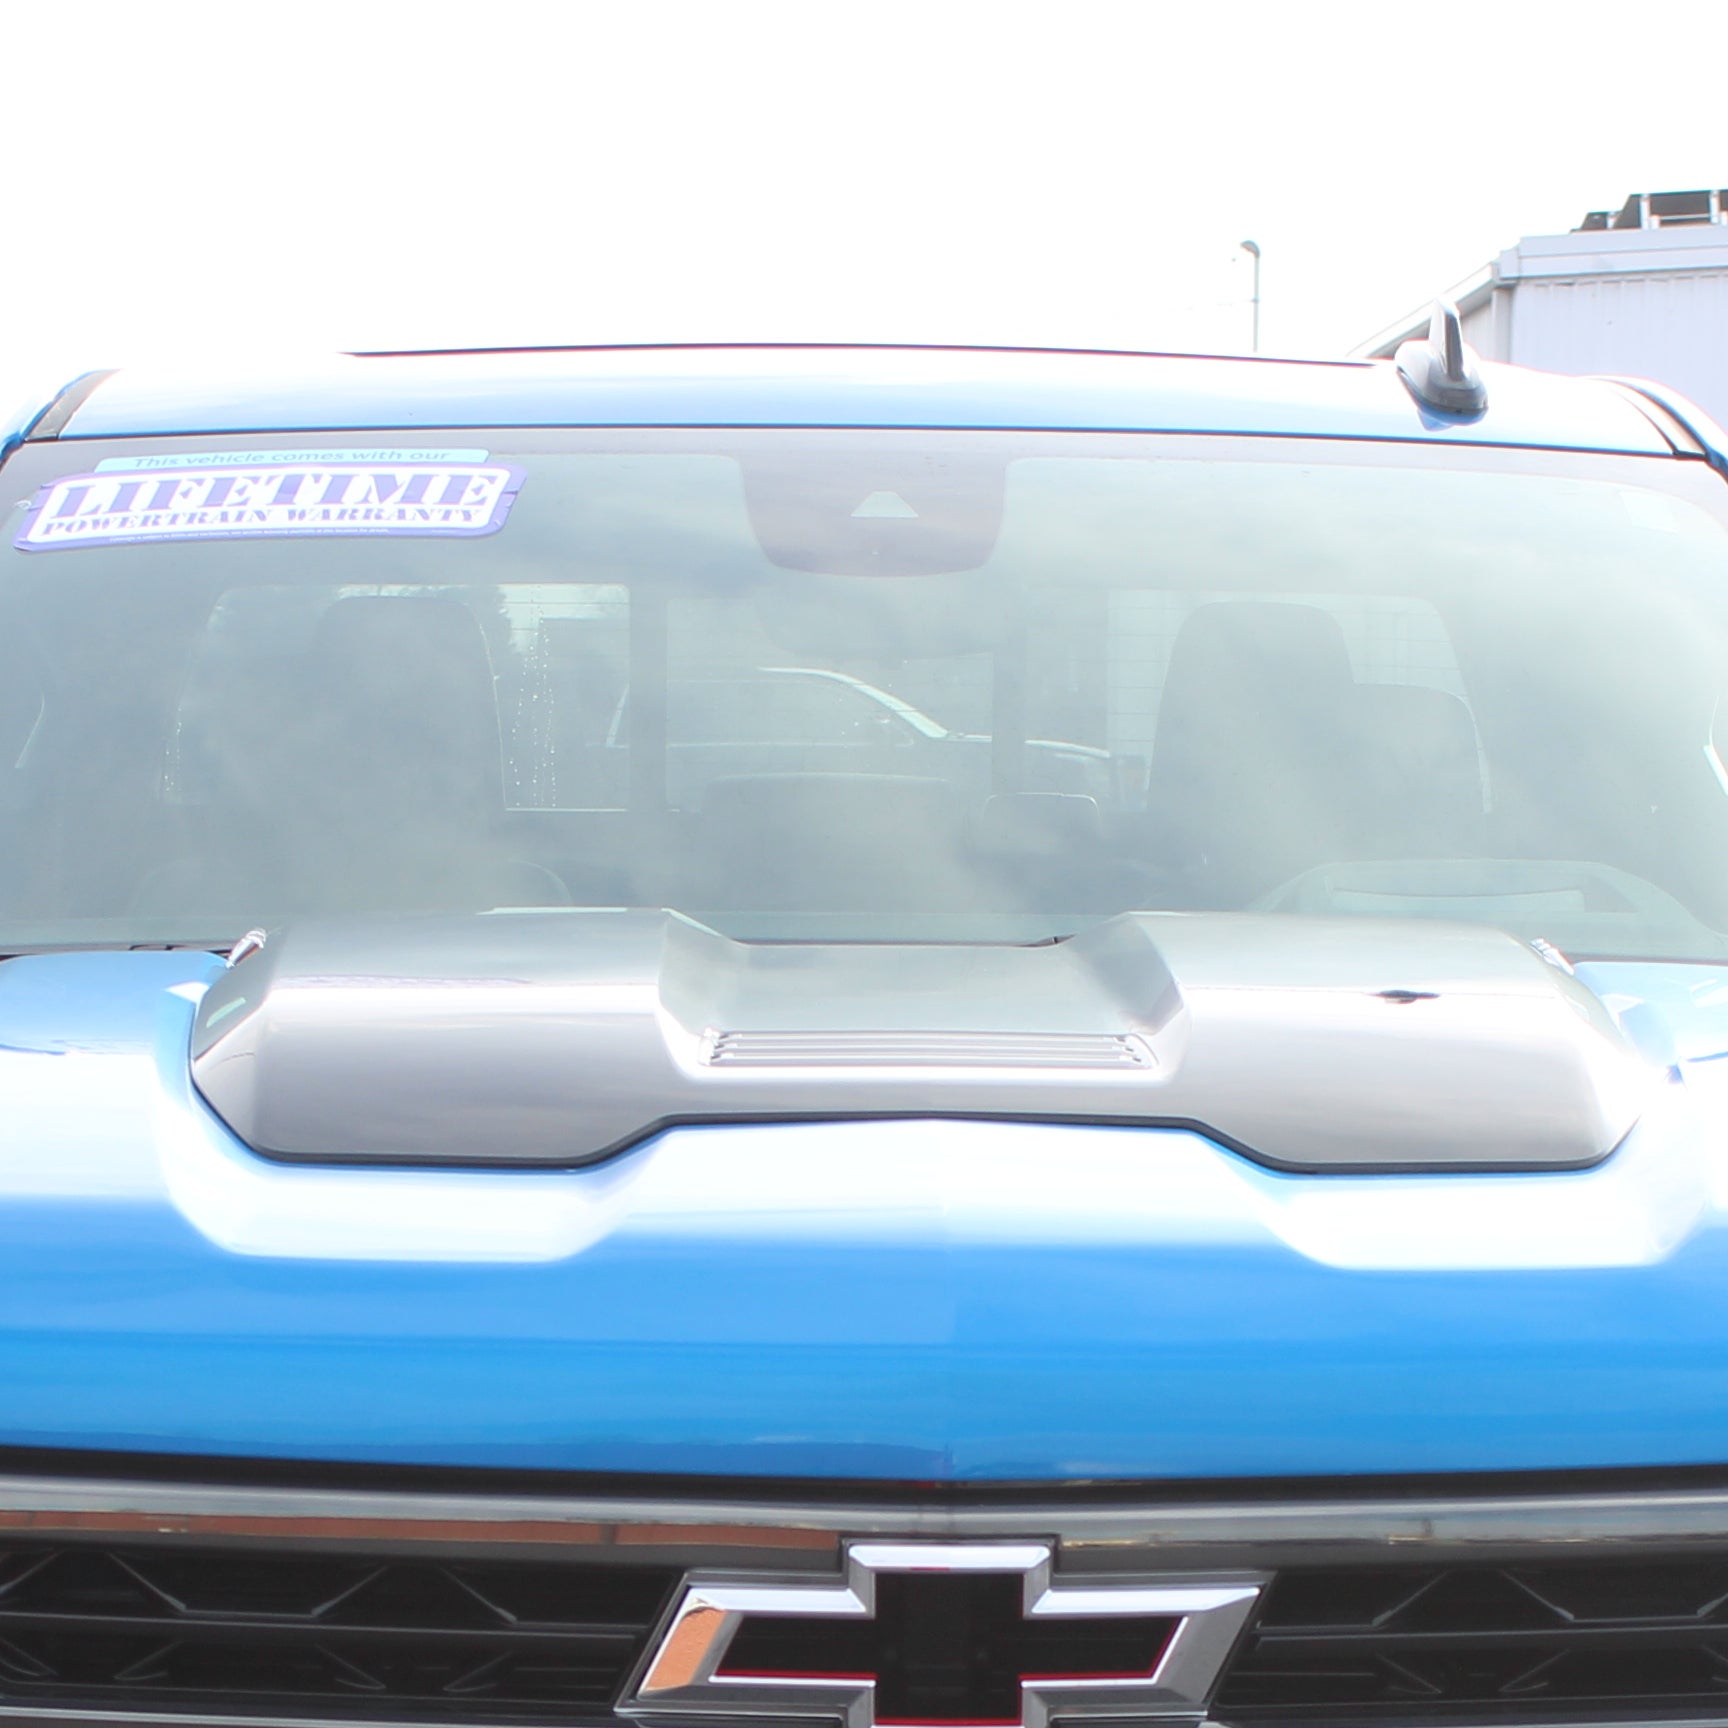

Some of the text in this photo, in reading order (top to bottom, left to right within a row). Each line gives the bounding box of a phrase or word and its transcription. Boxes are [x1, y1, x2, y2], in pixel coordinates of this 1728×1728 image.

[134, 450, 451, 469] This vehicle comes with our
[49, 473, 499, 520] LIFETIME
[40, 508, 273, 537] POWERTRAIN
[286, 507, 484, 523] WARRANTY
